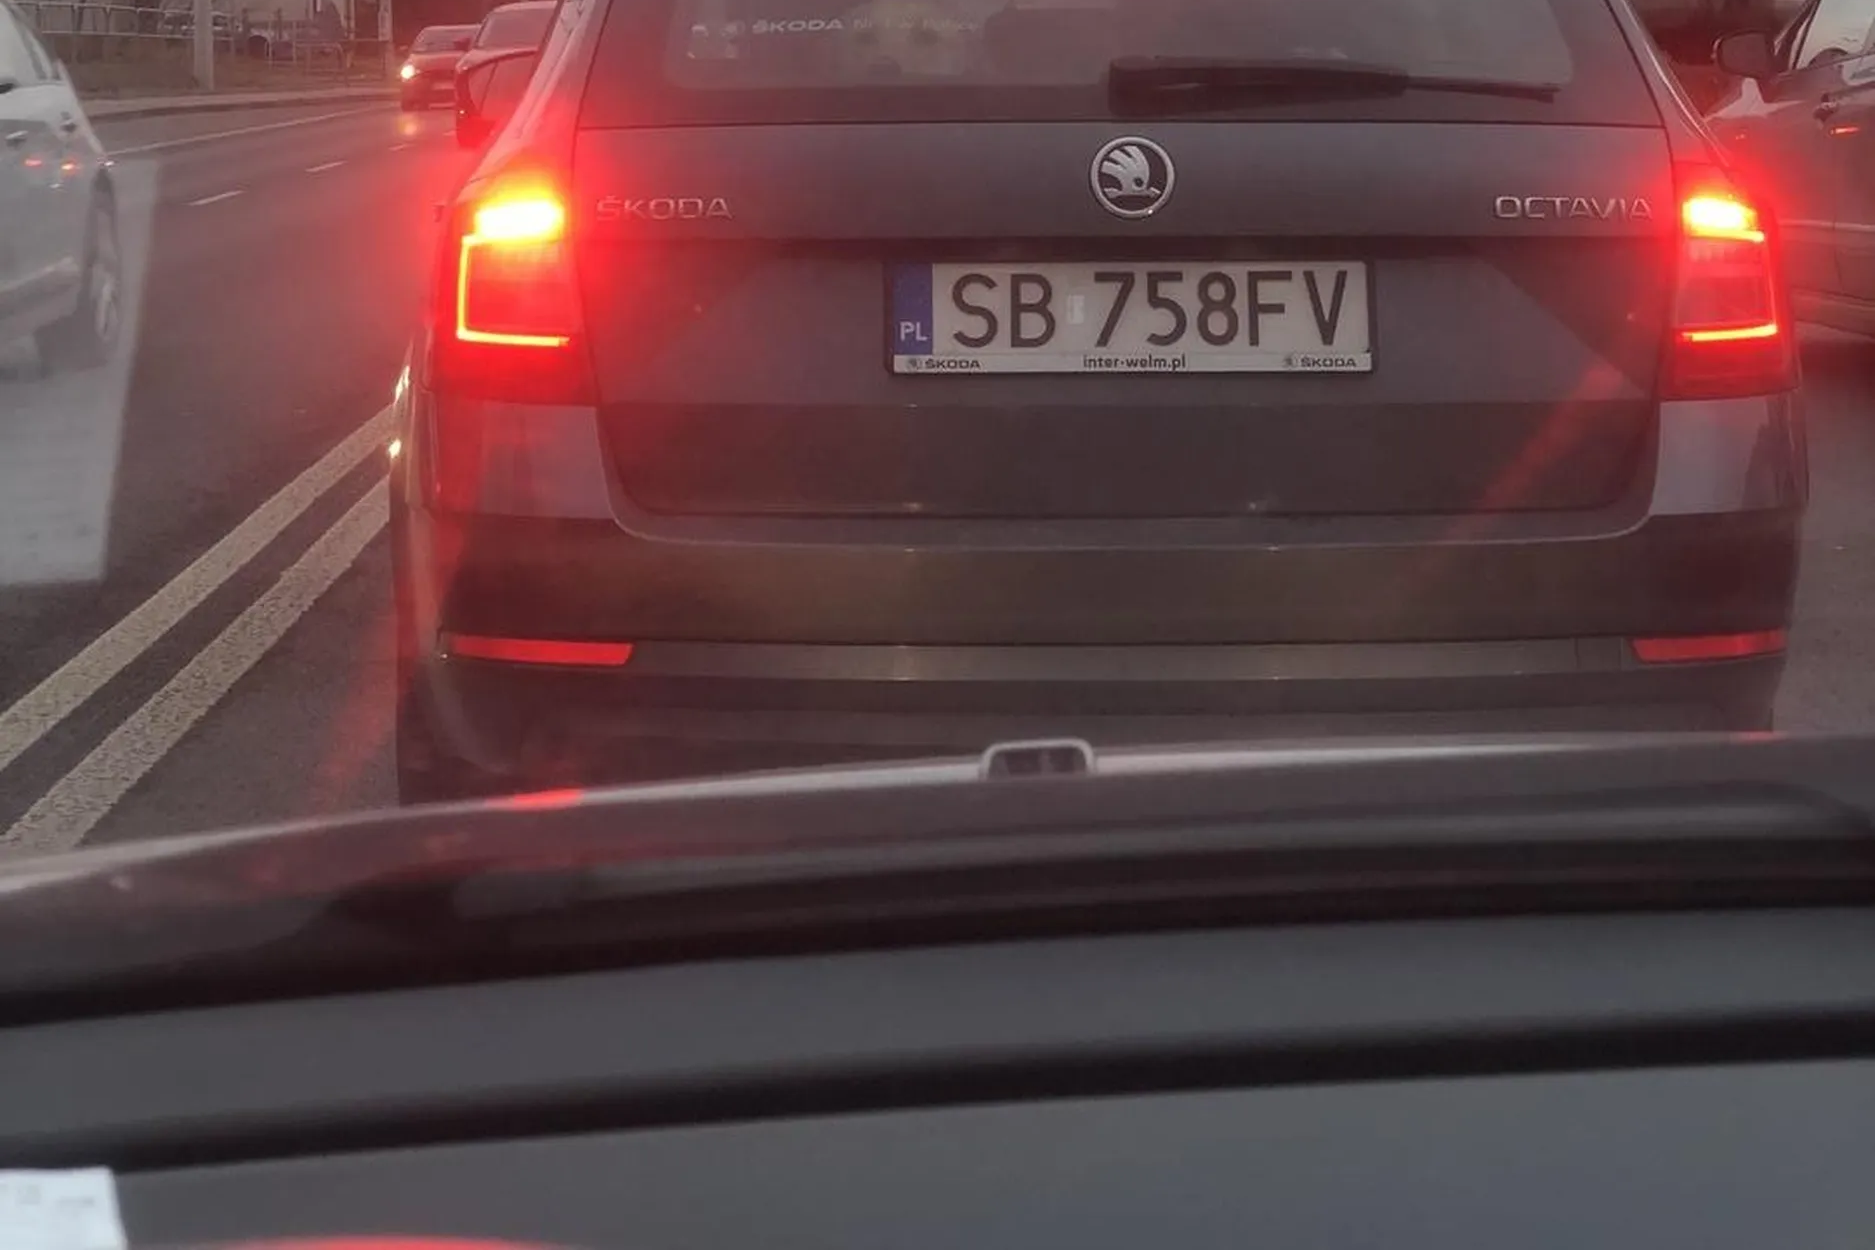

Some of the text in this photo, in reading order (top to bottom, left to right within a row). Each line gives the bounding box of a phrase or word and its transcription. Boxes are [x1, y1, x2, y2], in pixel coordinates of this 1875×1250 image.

[596, 196, 732, 221] ŠKODA
[1495, 197, 1652, 219] OCTAVIA
[951, 270, 1348, 348] SB 758FV
[900, 322, 927, 342] PL
[1083, 354, 1186, 370] inter-welm.pl
